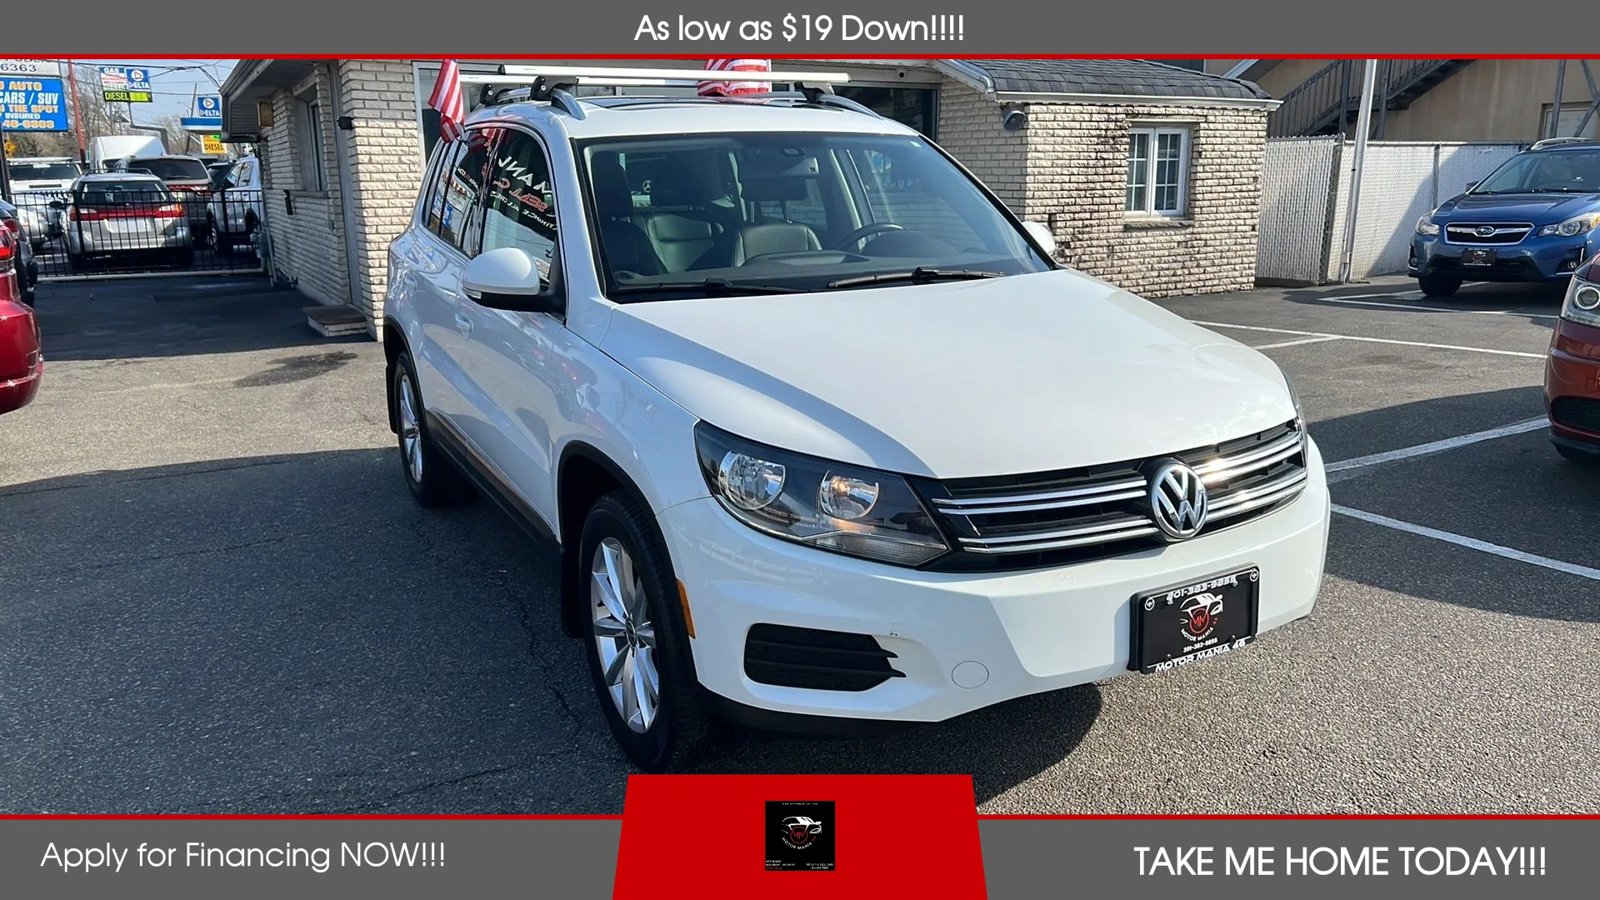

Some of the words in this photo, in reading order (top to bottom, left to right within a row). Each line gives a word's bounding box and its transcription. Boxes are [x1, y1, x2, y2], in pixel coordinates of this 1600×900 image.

[9, 81, 42, 91] AUTO
[128, 81, 150, 89] DELTA
[0, 92, 25, 104] CARS
[38, 92, 58, 105] SUV
[105, 91, 130, 101] DIESEL
[8, 104, 28, 113] THE
[31, 105, 58, 113] SPOT
[200, 109, 220, 117] DELTA
[204, 143, 224, 151] DIESEL
[1154, 654, 1195, 672] MOTOR
[1195, 642, 1231, 661] MANIA
